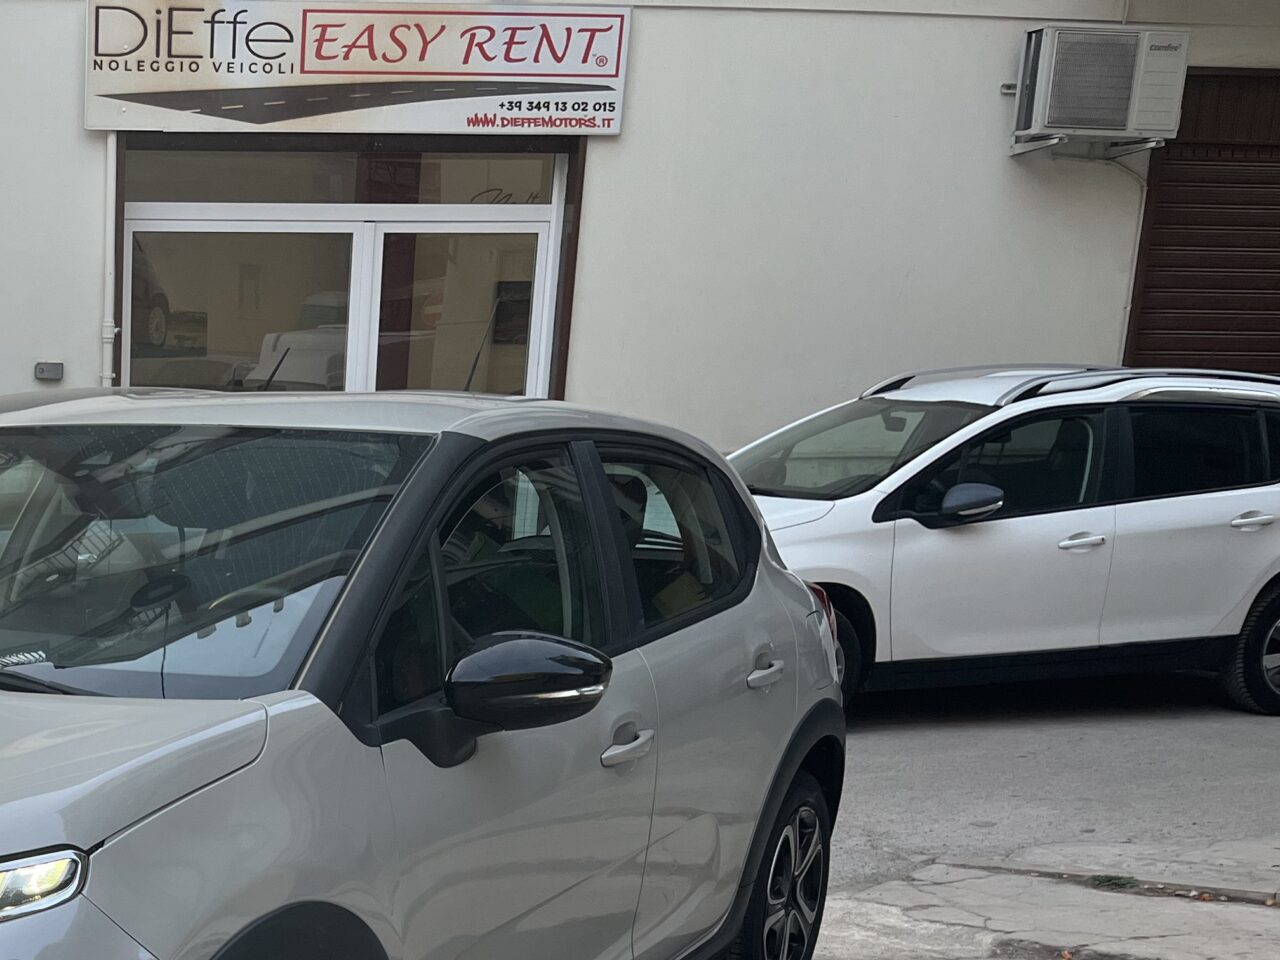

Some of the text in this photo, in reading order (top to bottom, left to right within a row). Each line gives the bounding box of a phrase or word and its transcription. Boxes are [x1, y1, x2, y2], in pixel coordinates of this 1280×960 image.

[95, 6, 294, 60] DiEffe
[313, 23, 446, 64] EASY
[93, 59, 294, 74] NOLEGGIO VEICOLI
[498, 101, 616, 112] +39 349 13 02 015
[466, 113, 614, 129] WWW.DIEFFEMOTORS.IT
